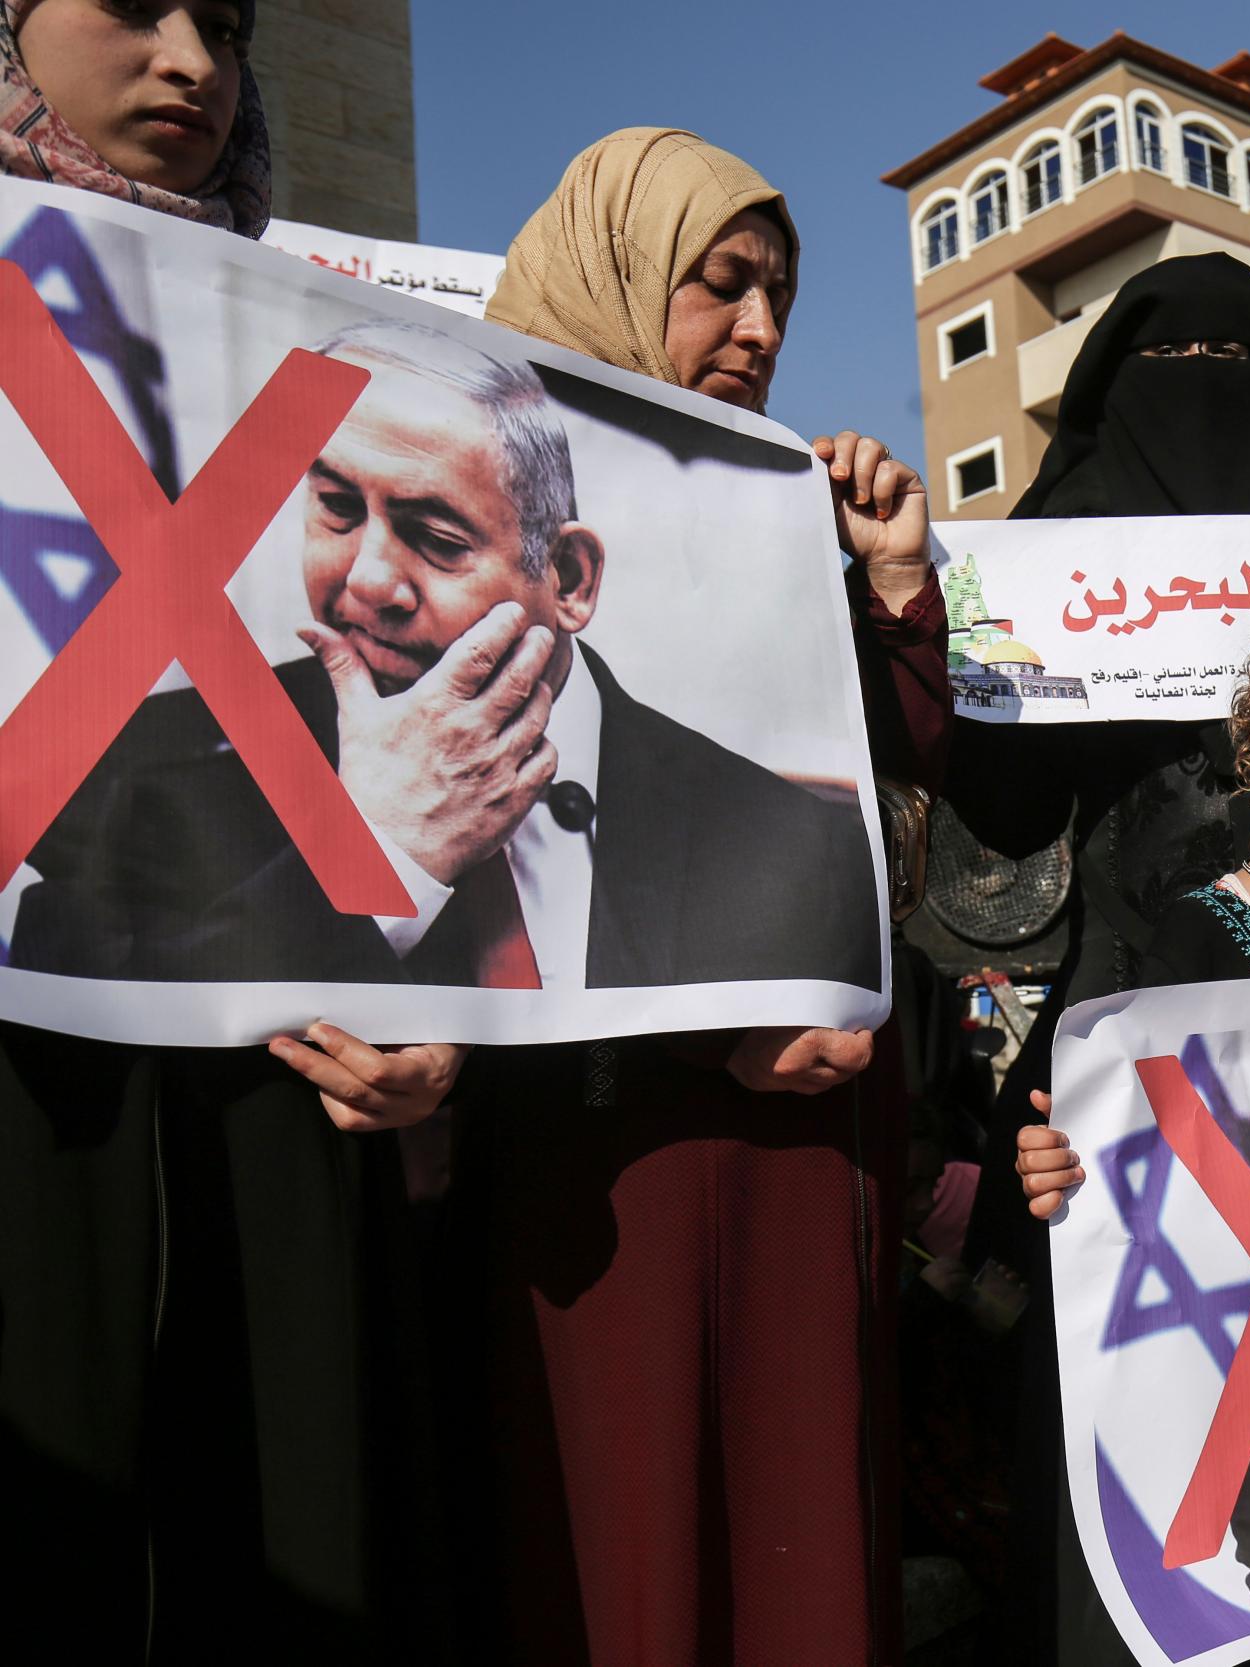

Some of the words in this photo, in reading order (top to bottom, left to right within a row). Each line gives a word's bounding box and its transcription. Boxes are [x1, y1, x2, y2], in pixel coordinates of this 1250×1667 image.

[377, 268, 426, 292] مؤتمر
[432, 275, 486, 304] يسقط
[1090, 669, 1111, 684] رفح
[1199, 665, 1228, 679] العمل
[1134, 687, 1189, 702] الفعاليات
[1191, 685, 1217, 700] لجنة
